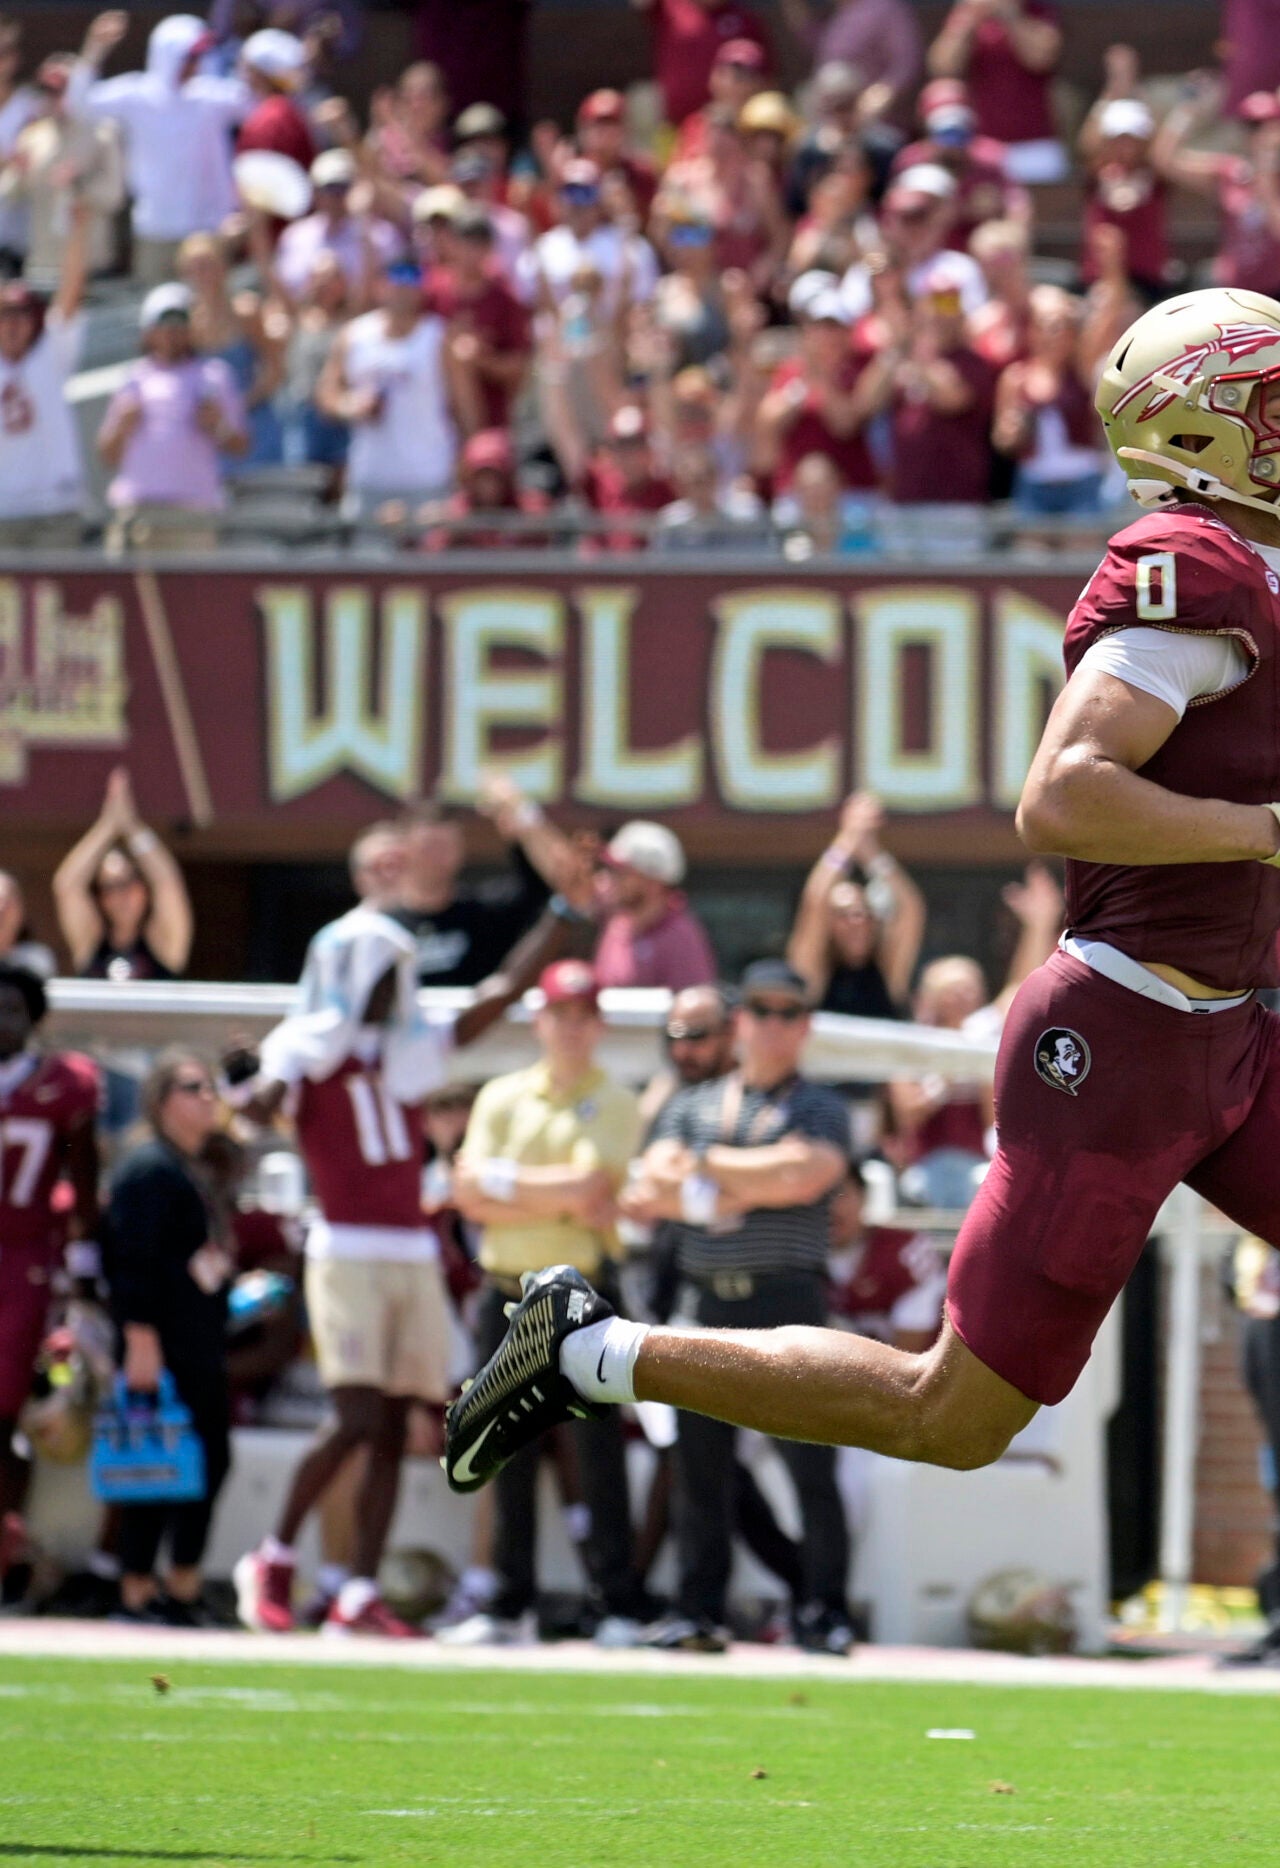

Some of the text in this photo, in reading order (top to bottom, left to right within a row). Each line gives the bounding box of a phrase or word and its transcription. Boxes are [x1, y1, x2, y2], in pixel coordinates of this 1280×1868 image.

[1136, 552, 1177, 621] 0
[257, 583, 1068, 812] WELCO
[0, 1116, 52, 1207] 7
[345, 1074, 410, 1165] 11
